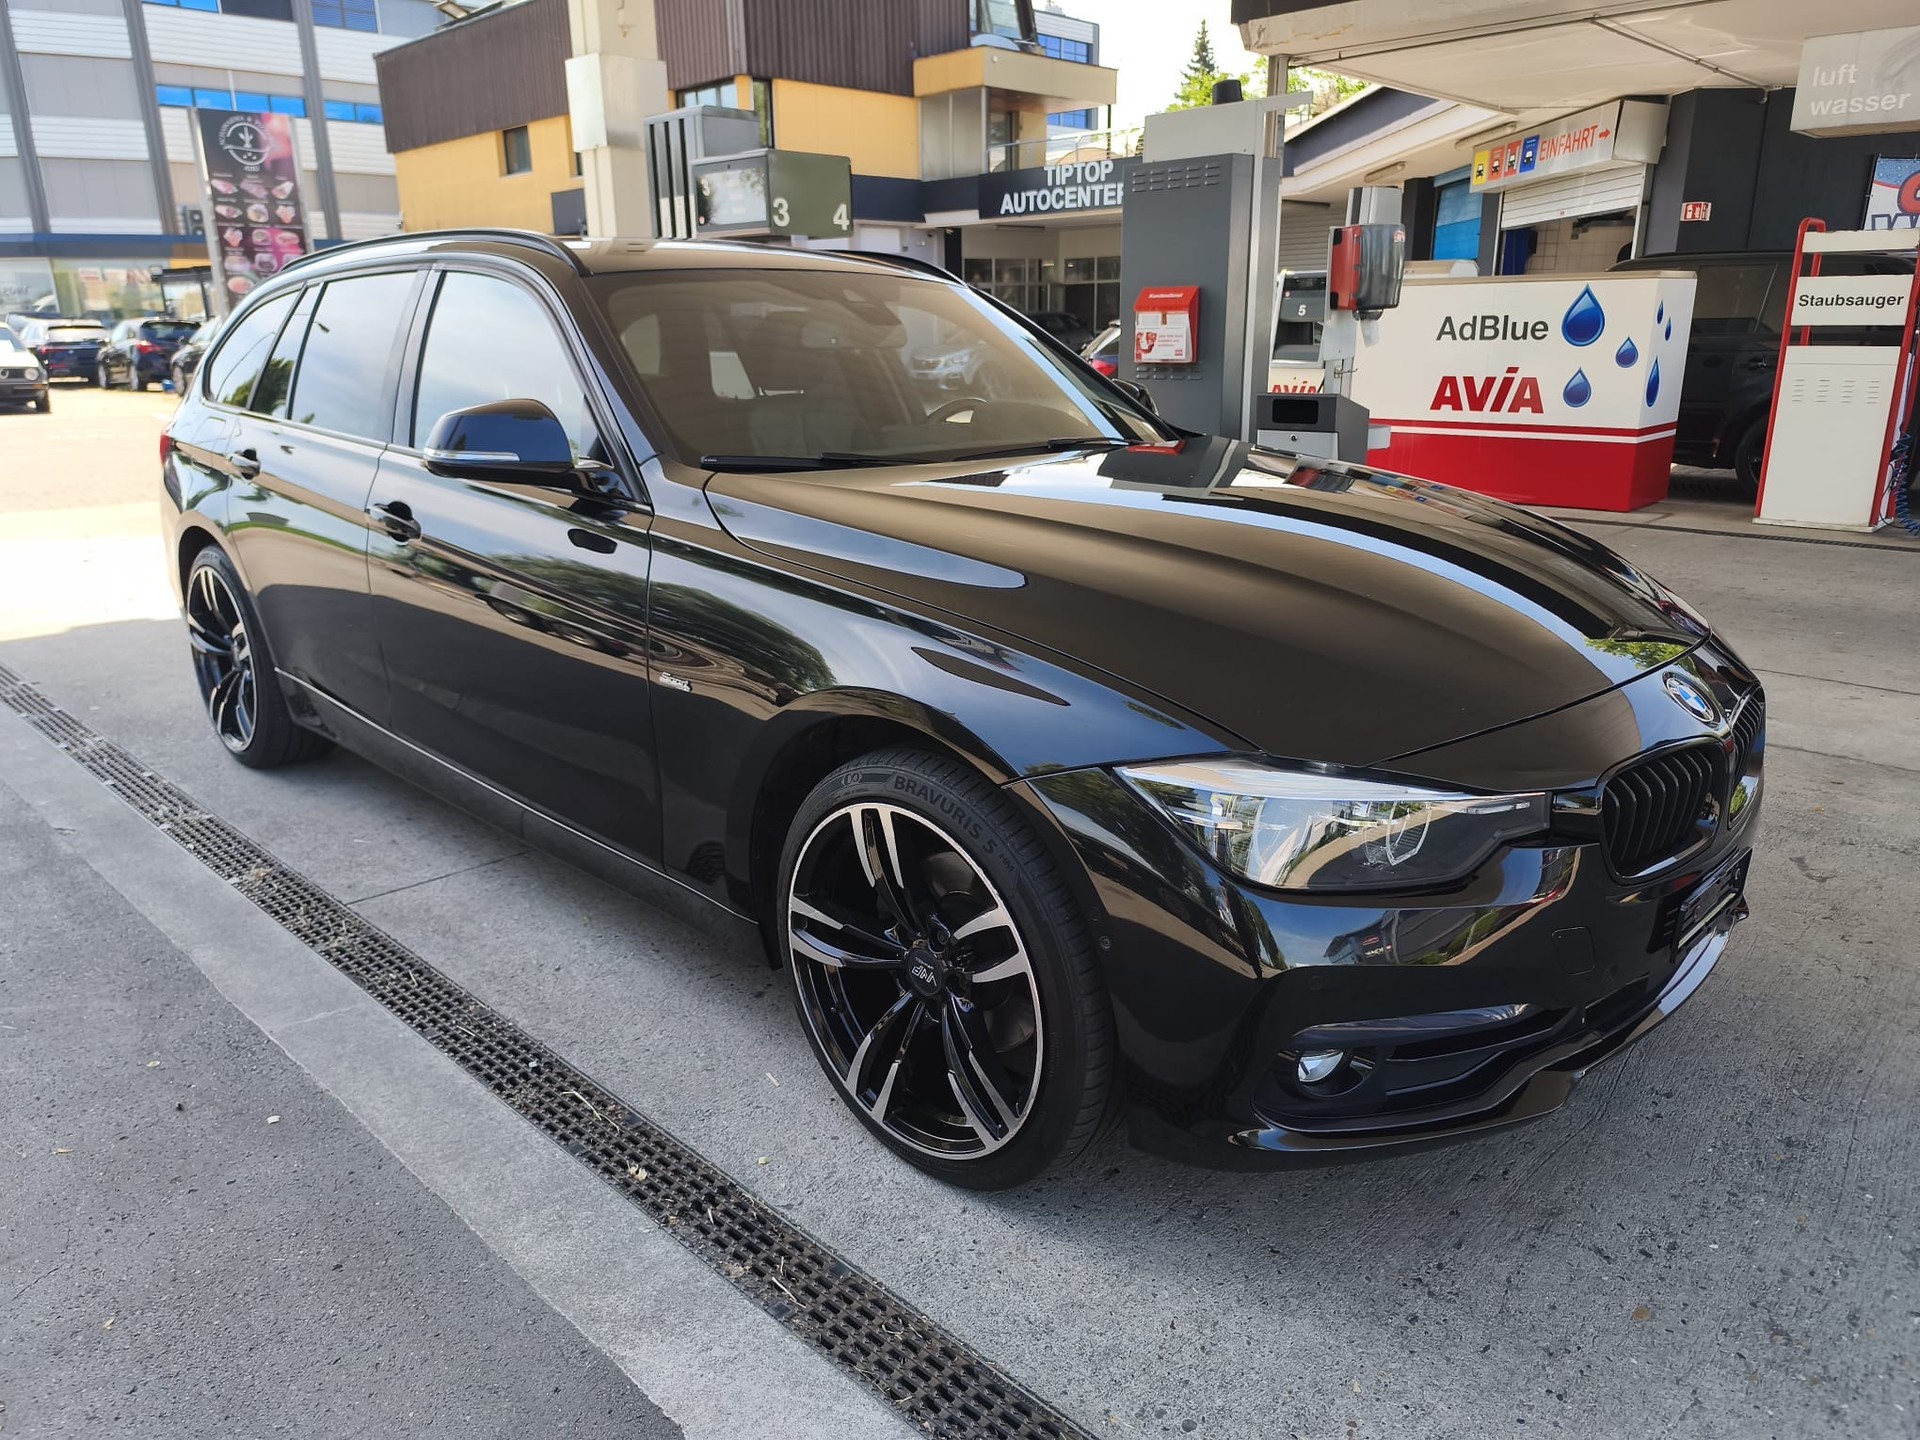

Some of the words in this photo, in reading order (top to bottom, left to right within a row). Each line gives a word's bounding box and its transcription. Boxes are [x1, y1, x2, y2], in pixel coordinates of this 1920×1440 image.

[1812, 63, 1858, 88] luft
[1810, 93, 1911, 116] wasser
[1539, 124, 1599, 161] EINFAHRT
[1044, 160, 1114, 187] TIPTOP
[772, 197, 791, 227] 3
[832, 203, 850, 231] 4
[1298, 304, 1307, 317] 5
[1798, 294, 1905, 309] Staubsauger
[1436, 315, 1549, 341] AdBlue
[1430, 366, 1544, 414] AVIA
[894, 775, 984, 840] BRAVURIS
[982, 838, 998, 854] 5
